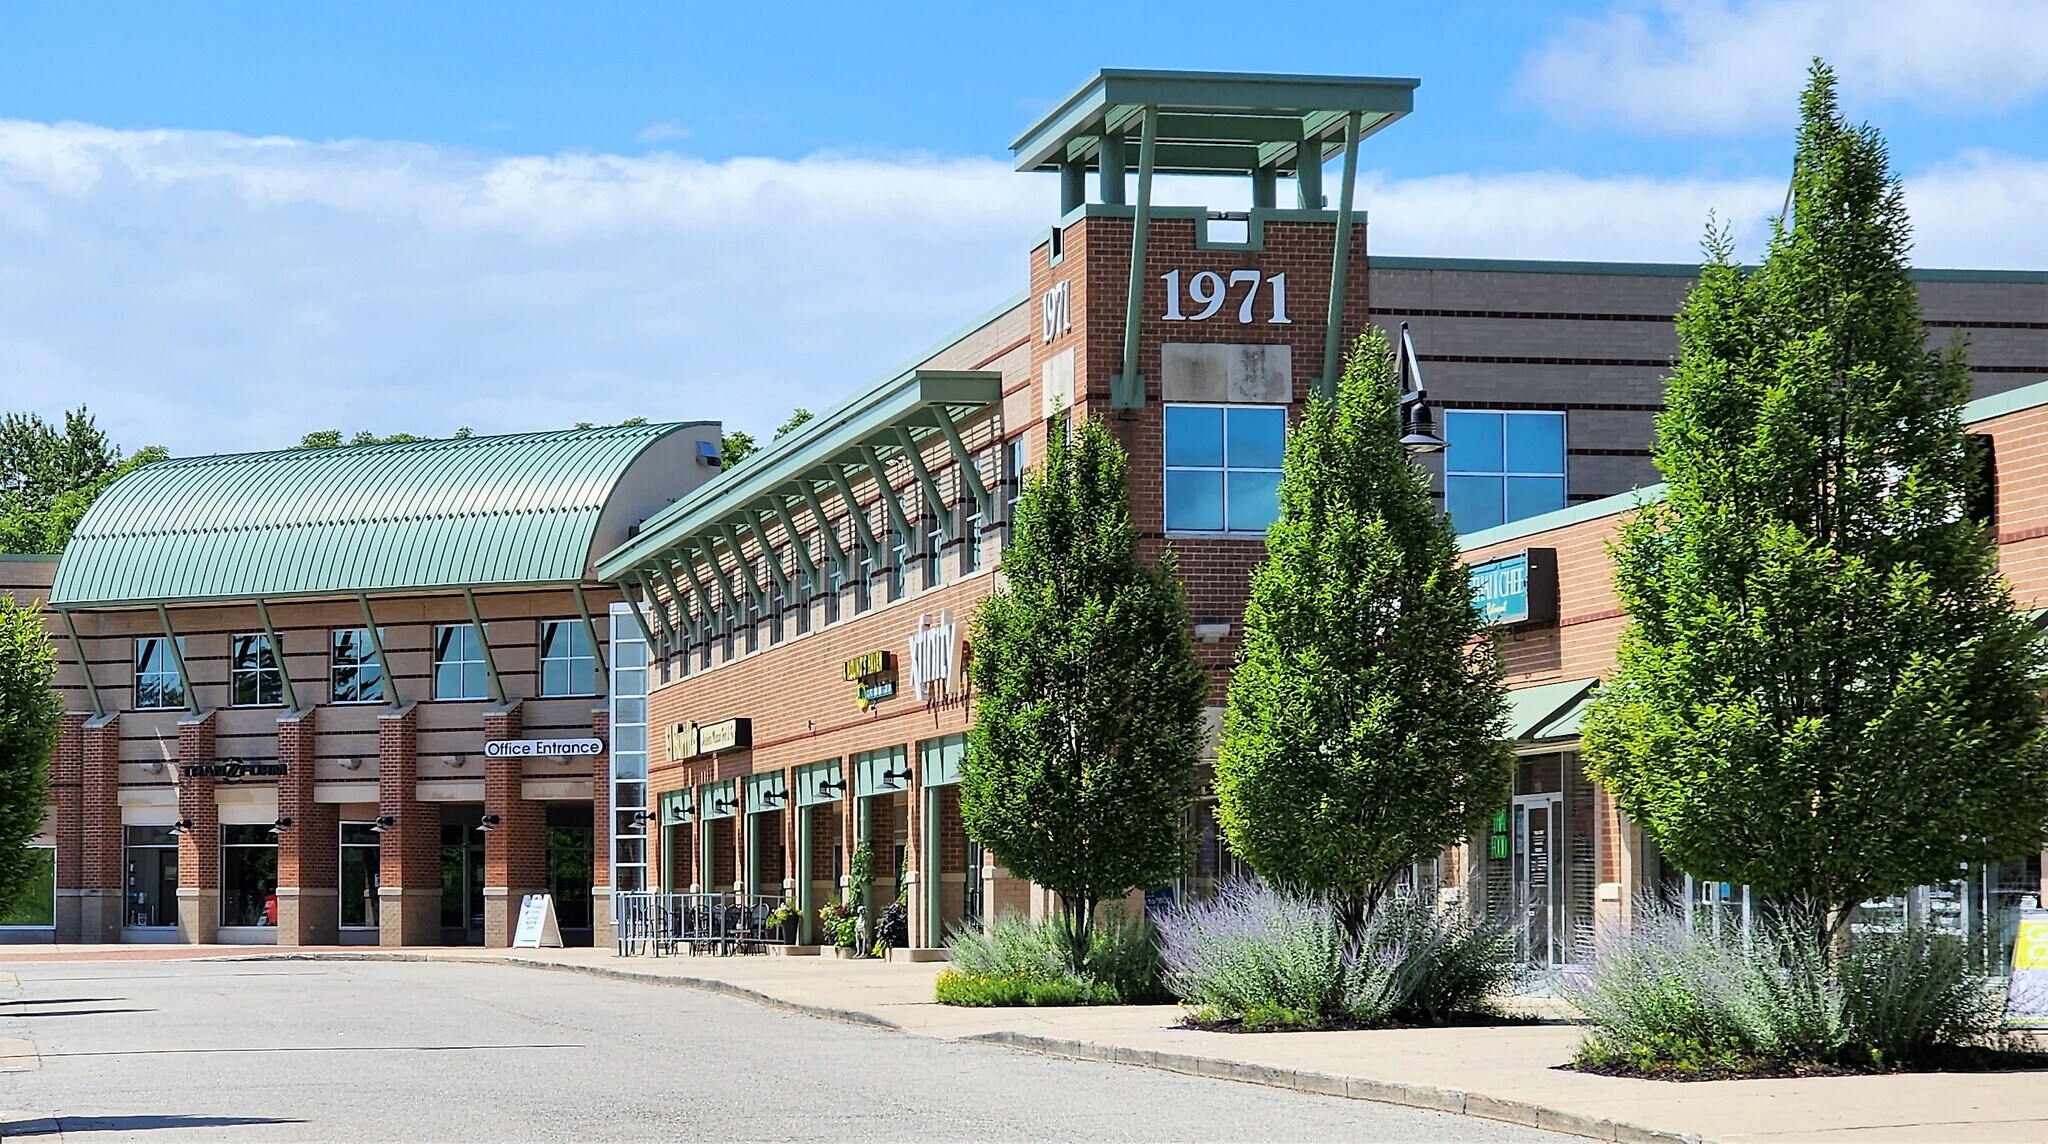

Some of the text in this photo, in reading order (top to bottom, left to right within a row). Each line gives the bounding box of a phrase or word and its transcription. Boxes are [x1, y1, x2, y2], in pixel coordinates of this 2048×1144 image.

[1042, 279, 1072, 343] 1971
[1160, 269, 1293, 324] 1971
[908, 608, 957, 700] xfinity
[488, 741, 600, 756] Office Entrance
